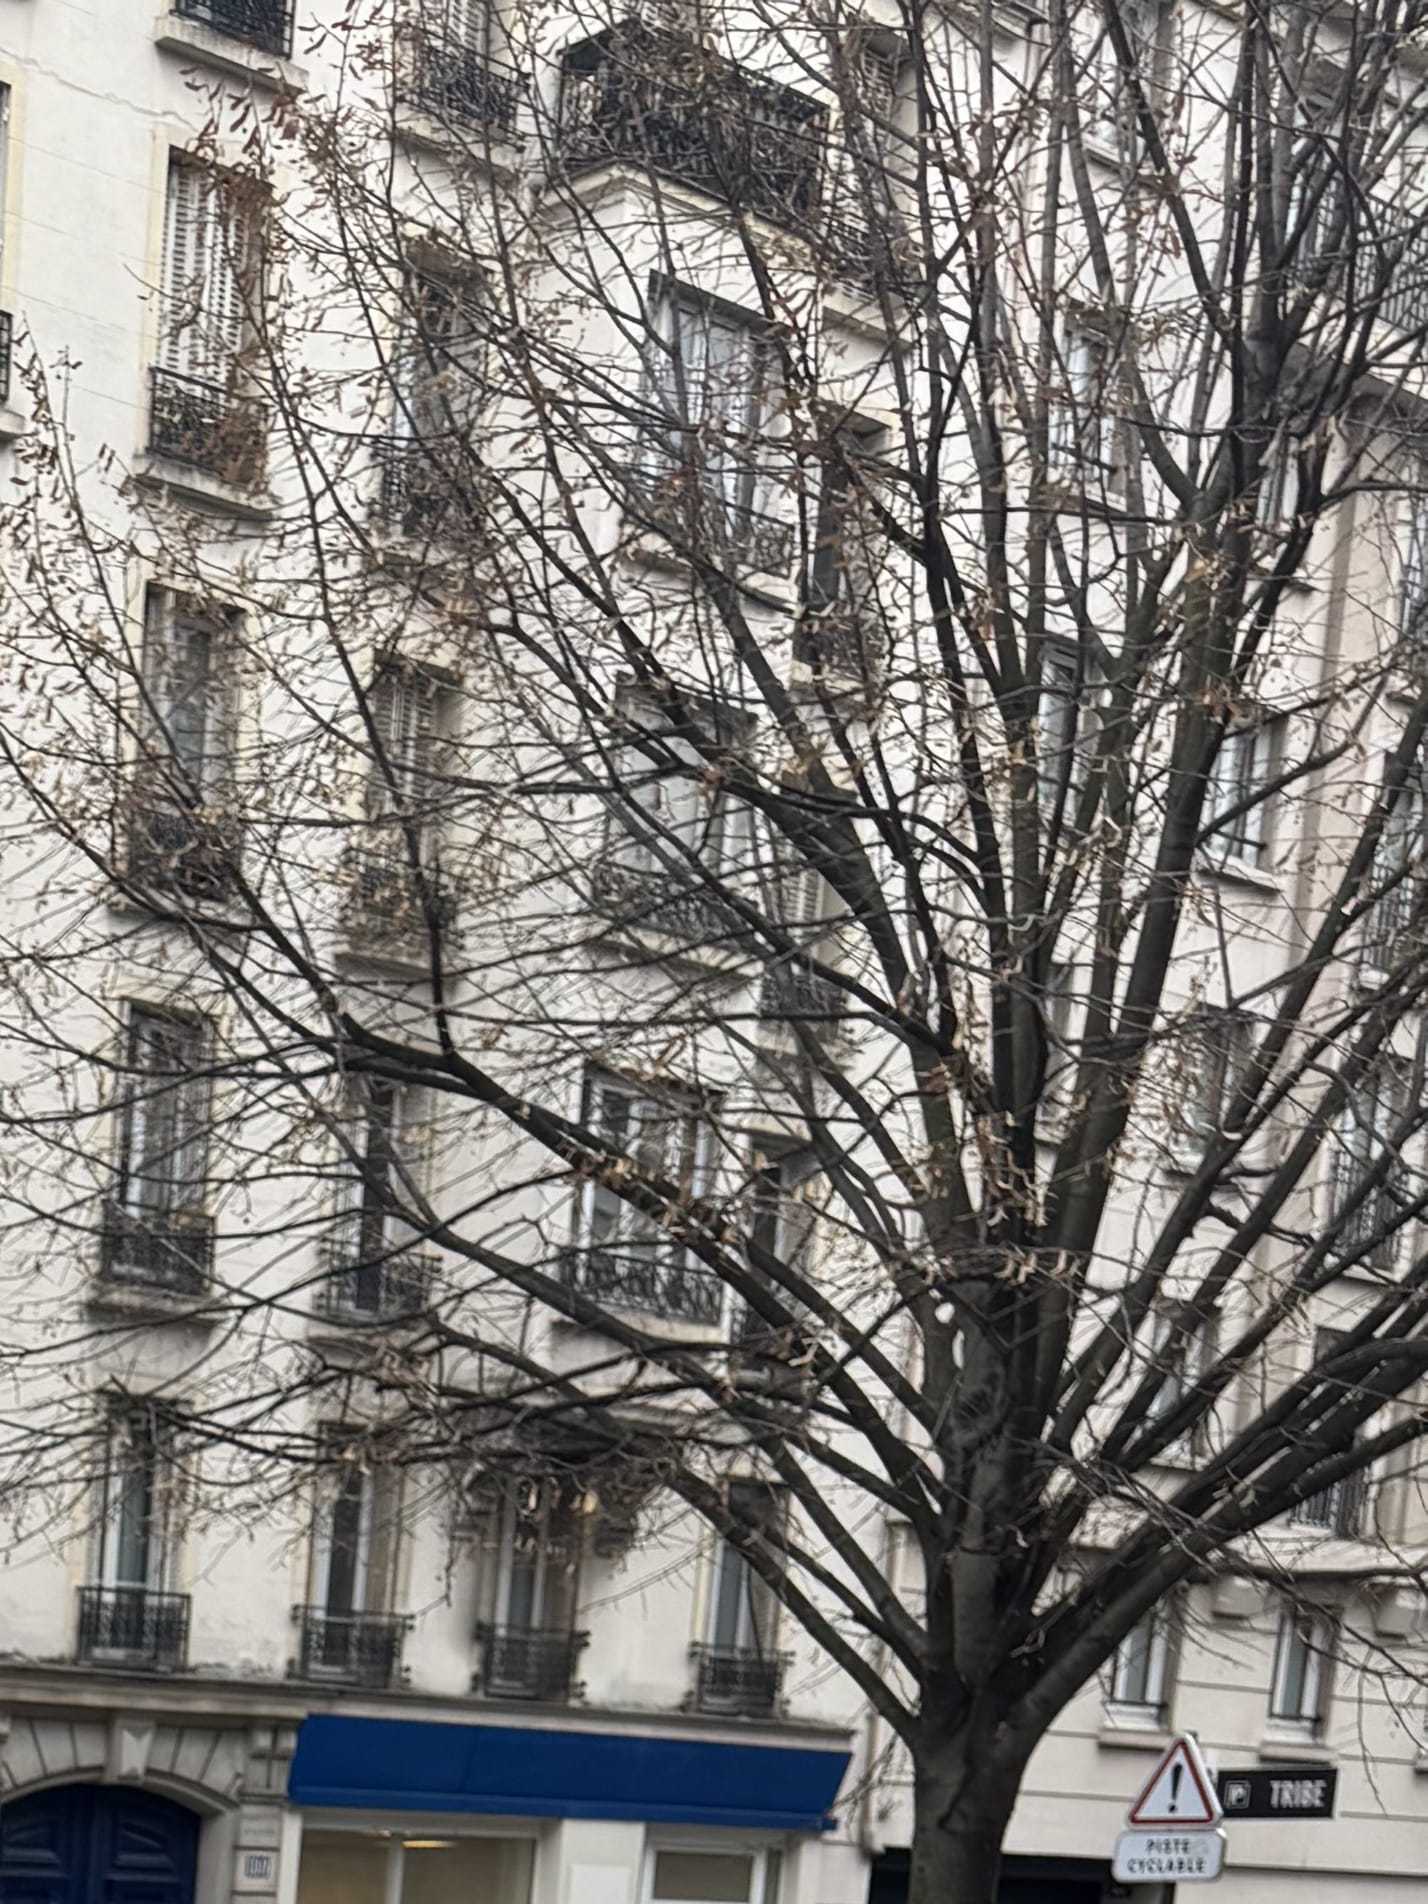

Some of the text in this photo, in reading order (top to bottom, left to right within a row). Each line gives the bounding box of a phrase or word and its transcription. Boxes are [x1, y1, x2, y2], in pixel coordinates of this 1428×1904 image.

[1268, 1778, 1328, 1809] TRIBE
[1146, 1837, 1192, 1855] PISTE
[1126, 1856, 1207, 1875] CYCLABLE
